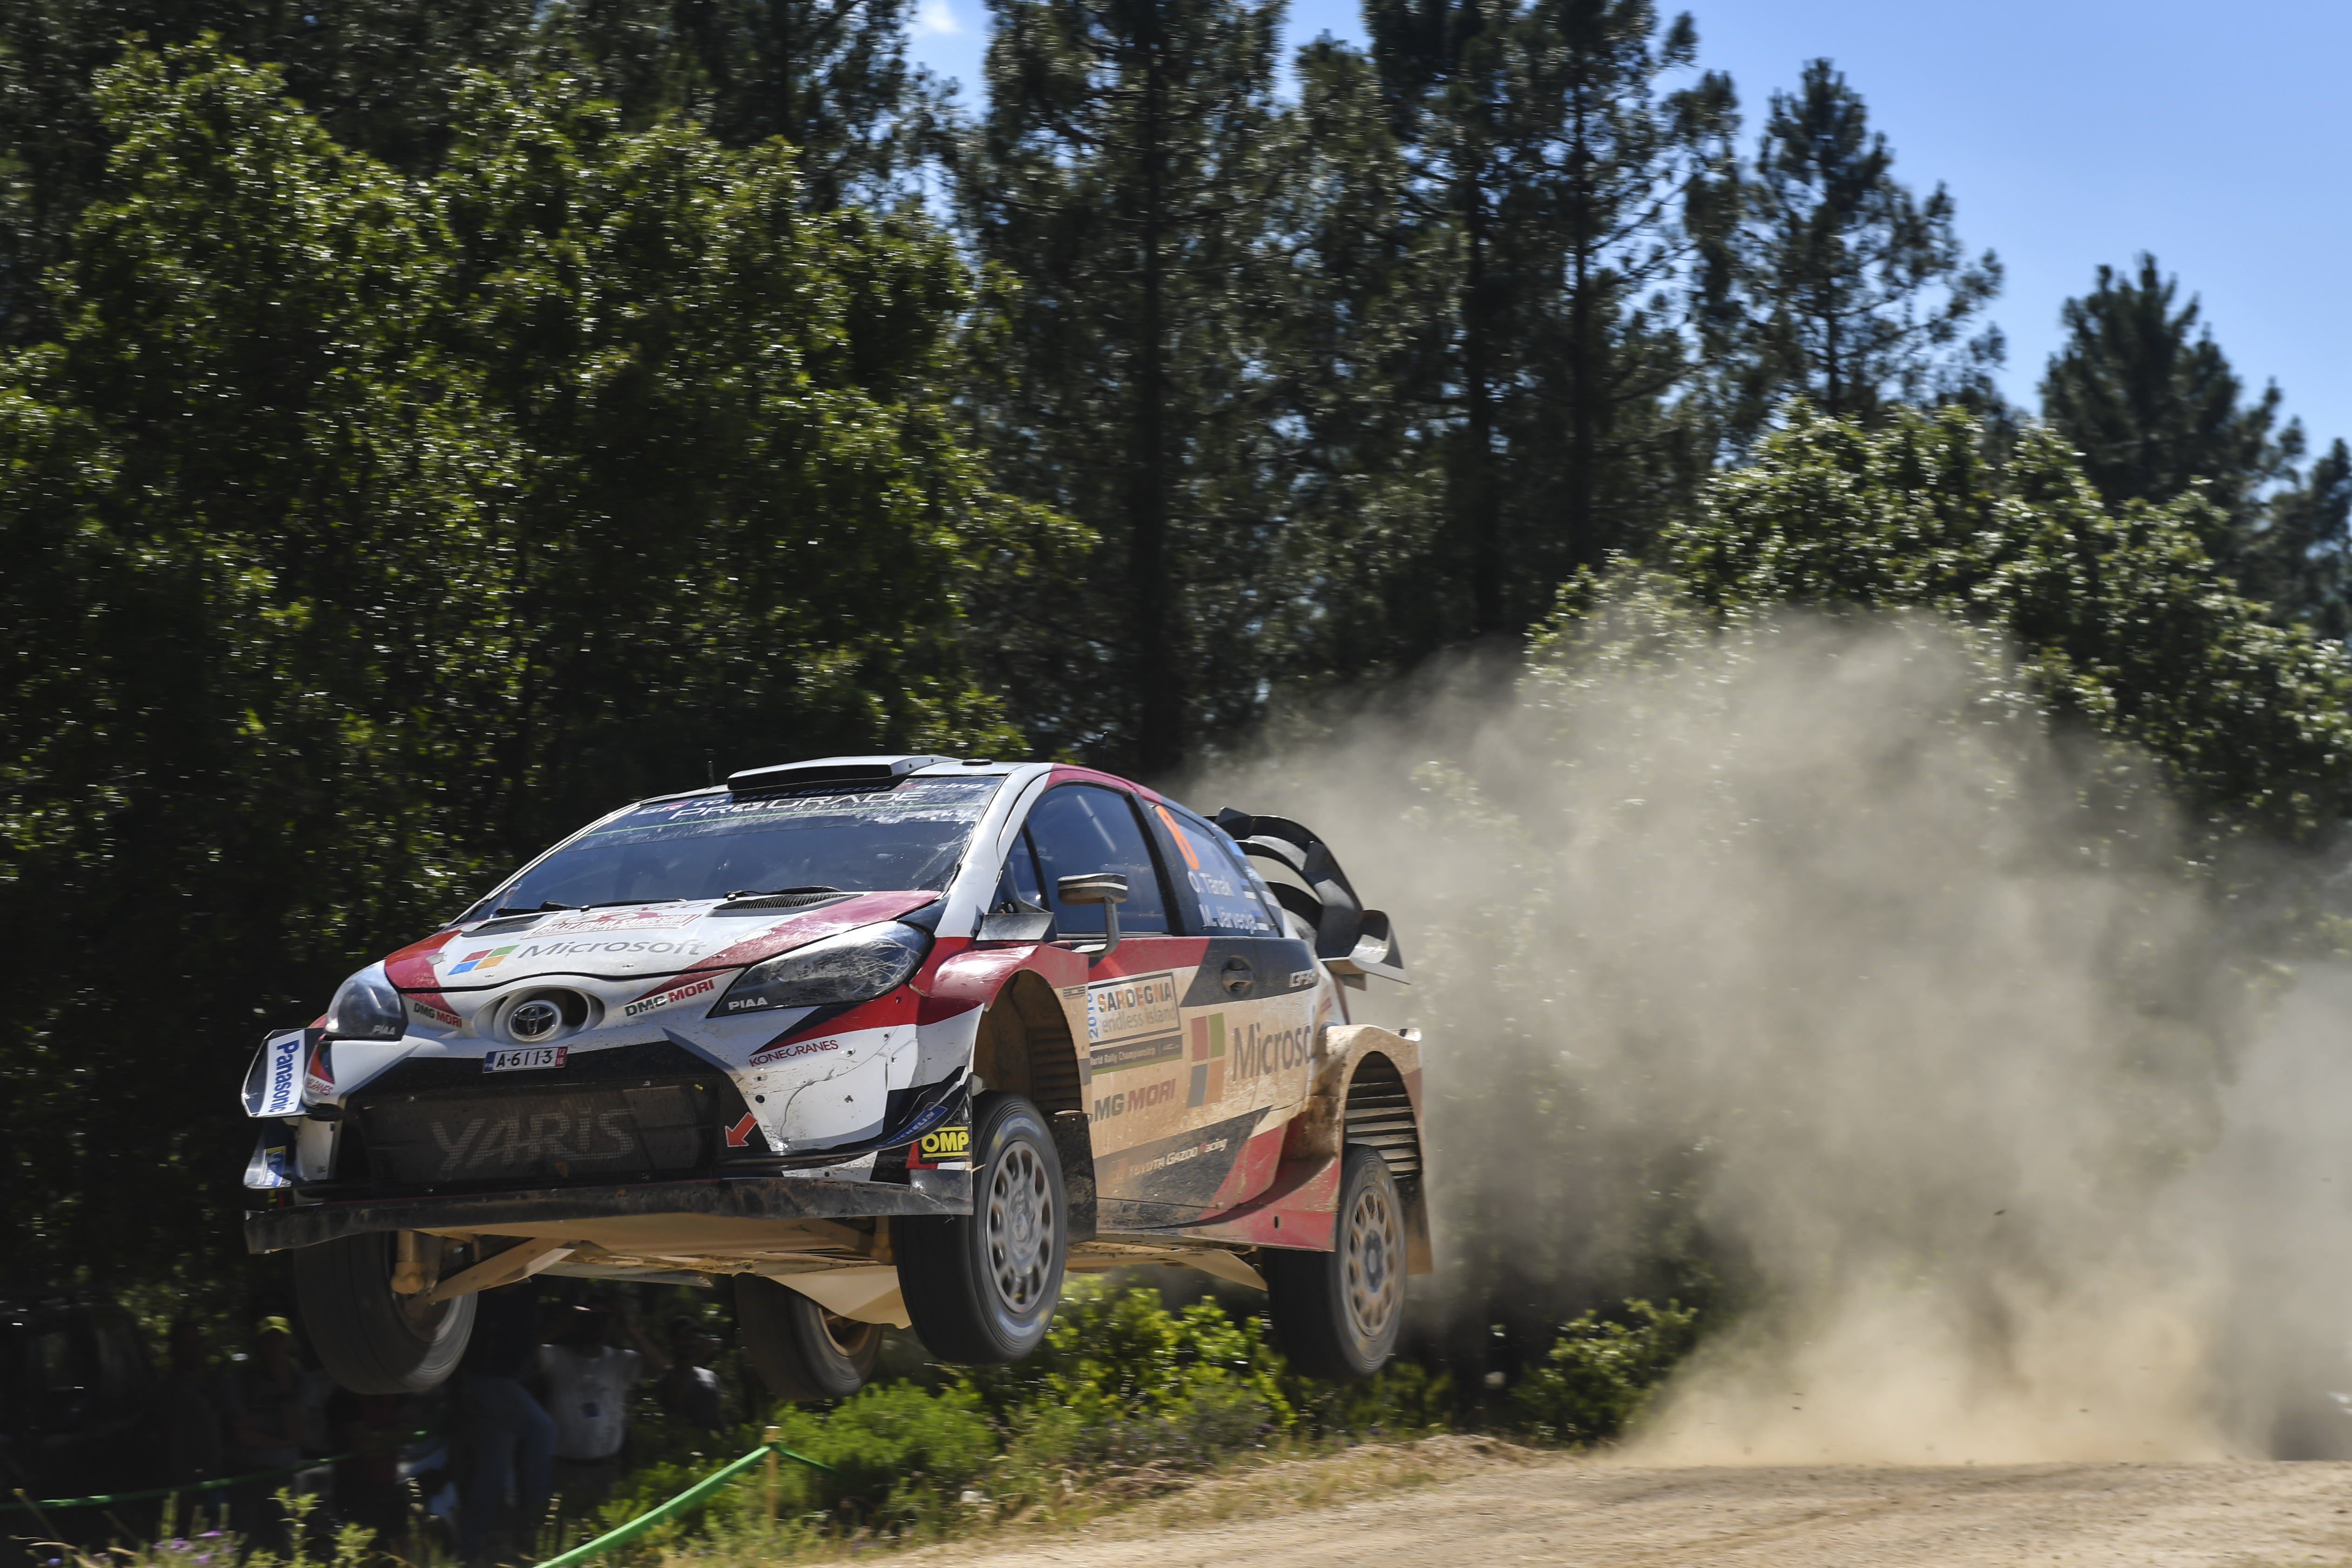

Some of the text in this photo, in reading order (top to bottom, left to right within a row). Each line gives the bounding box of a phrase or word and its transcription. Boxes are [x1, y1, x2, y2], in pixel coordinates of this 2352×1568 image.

[796, 785, 891, 796] GAZOO
[668, 791, 928, 820] PROGRADE
[794, 801, 915, 811] DIGITAL
[517, 939, 707, 959] Microsoft
[668, 979, 715, 1003] MORI
[728, 996, 768, 1011] PIAA
[1097, 982, 1173, 1013] SARDEGNA
[413, 1002, 462, 1028] DMG MORI
[1102, 1002, 1178, 1033] endless island
[372, 1024, 396, 1035] PIAA
[748, 1039, 839, 1068] KONECRANES
[268, 1039, 300, 1113] Panasonic
[1088, 1078, 1176, 1125] MG MORI
[921, 1131, 970, 1153] OMP
